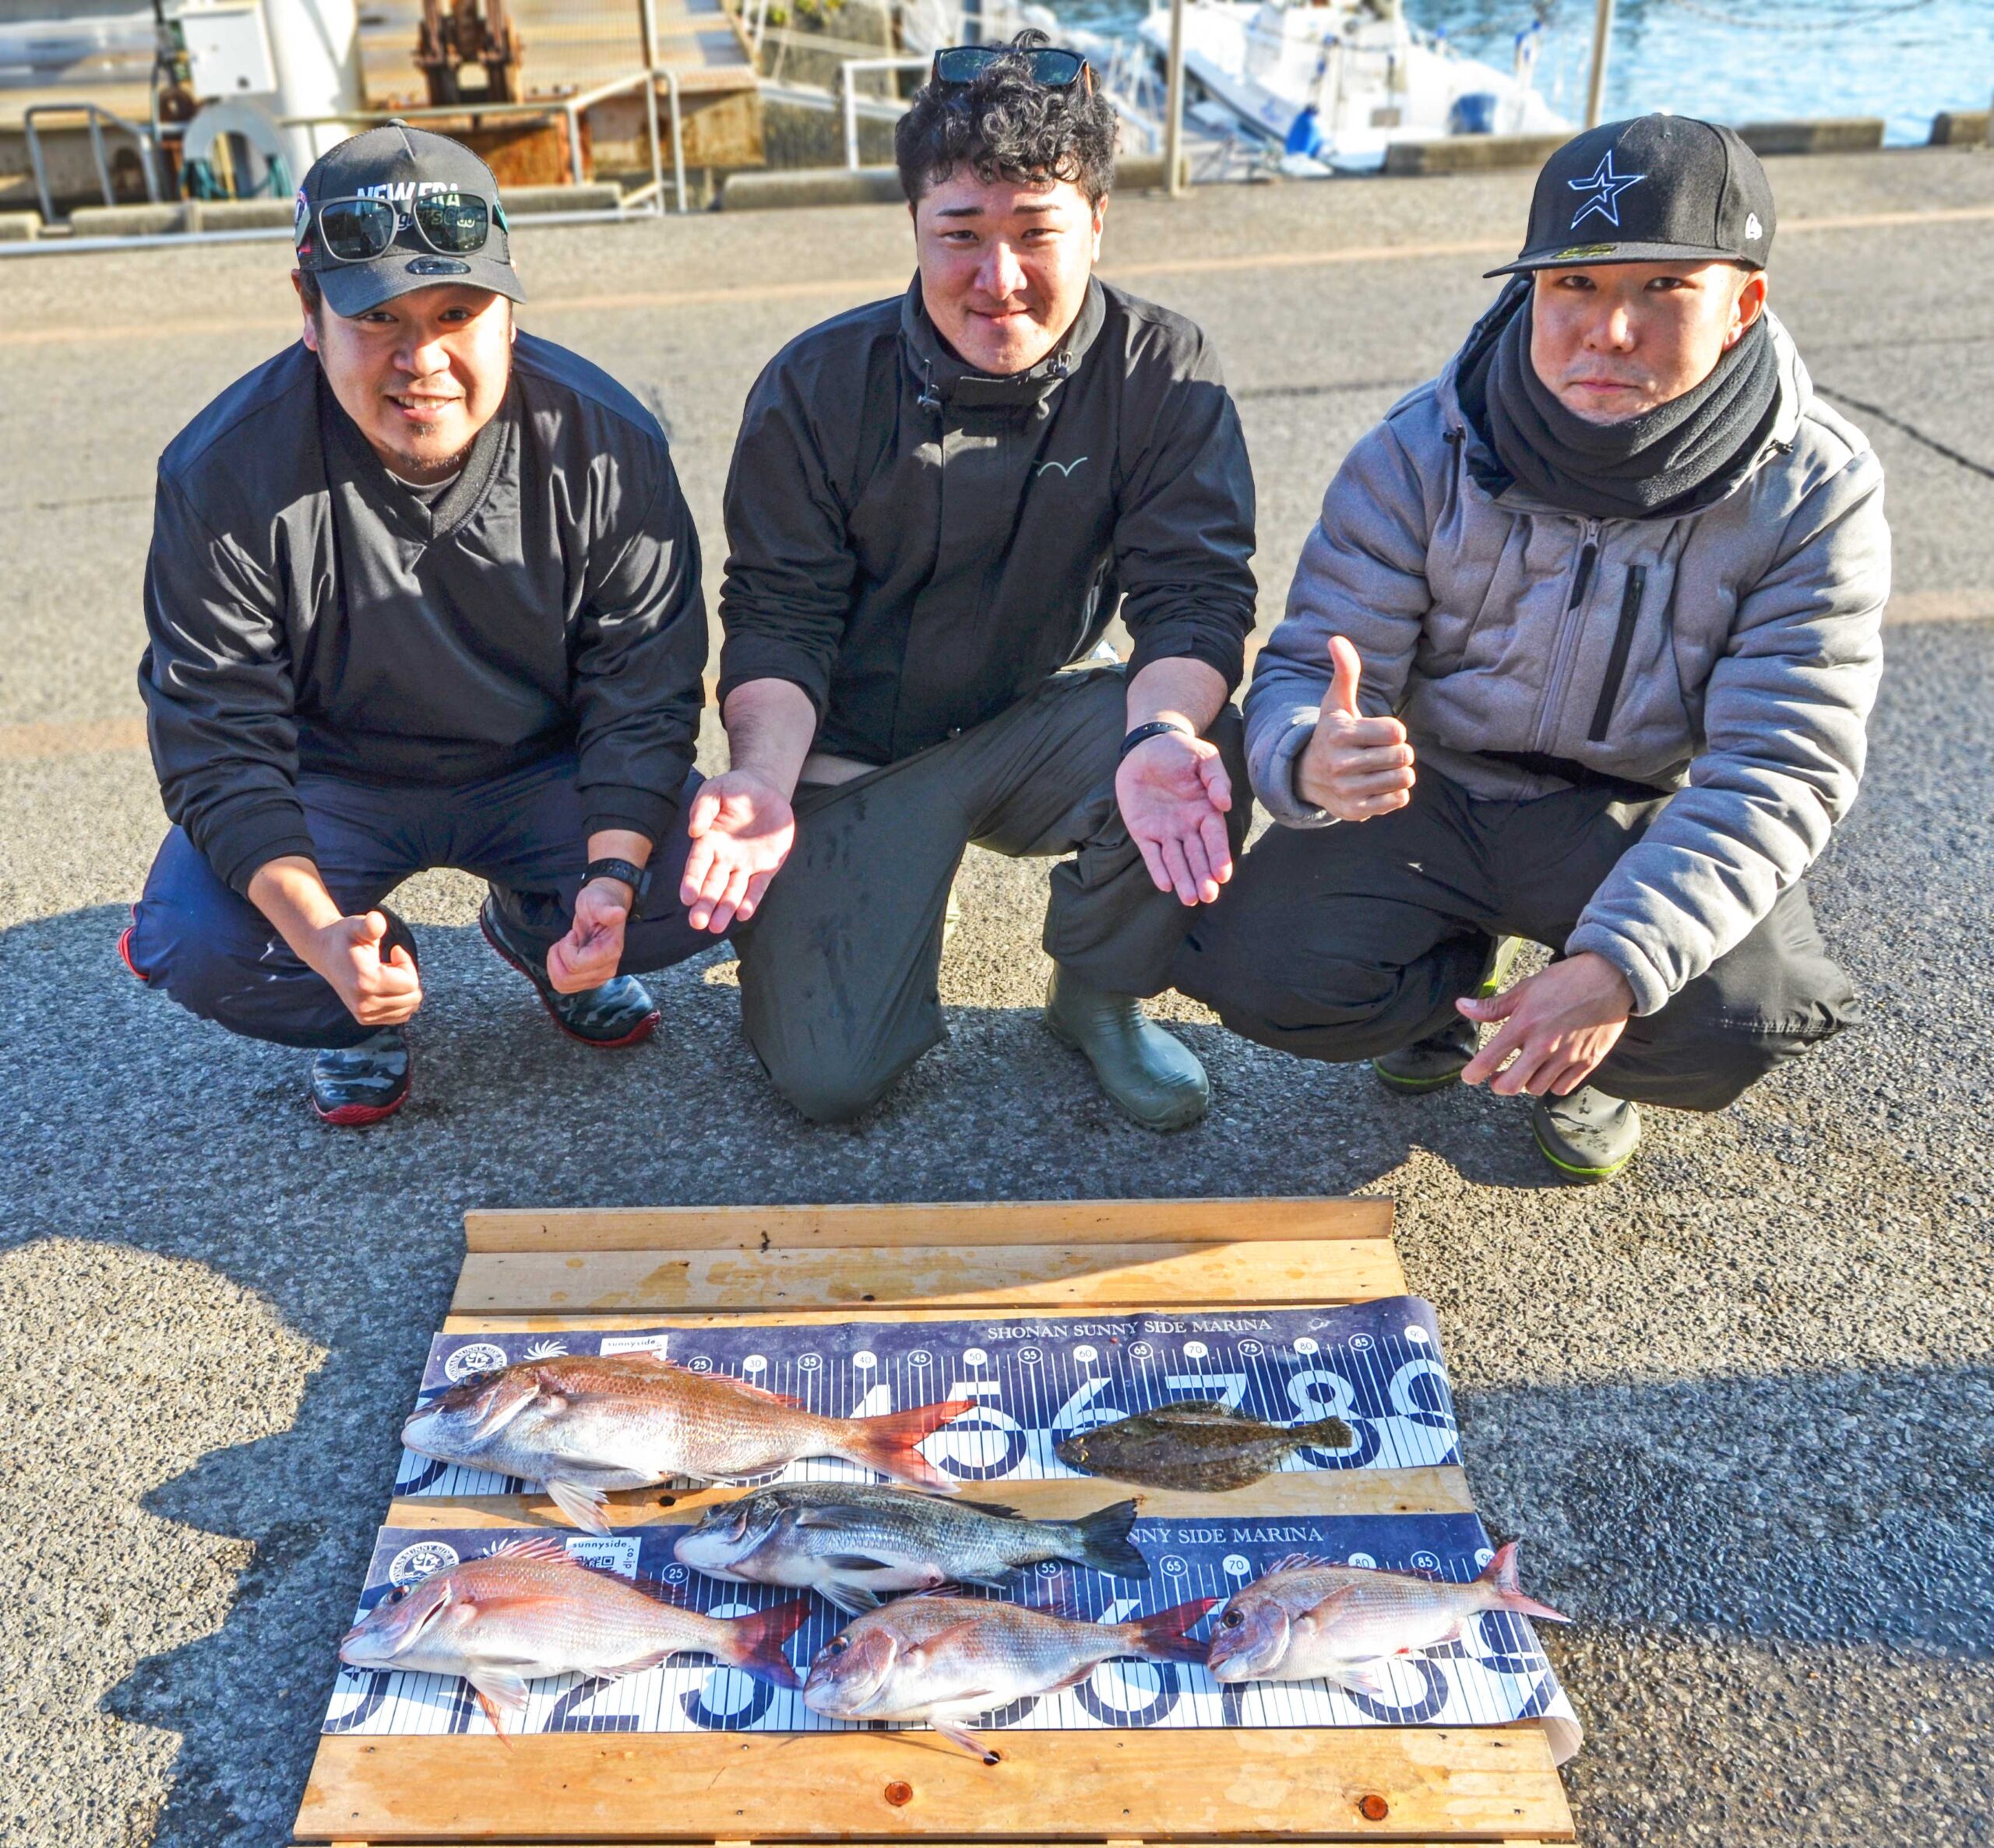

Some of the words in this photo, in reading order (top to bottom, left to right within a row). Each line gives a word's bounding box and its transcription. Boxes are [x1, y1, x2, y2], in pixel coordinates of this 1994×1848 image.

[355, 181, 416, 216] NEW
[417, 181, 461, 207] ERA
[988, 1325, 1068, 1339] SHONAN
[1073, 1322, 1138, 1337] SUNNY
[1144, 1320, 1187, 1333] SIDE
[1193, 1318, 1273, 1332] MARINA
[1244, 1343, 1257, 1352] 75
[1300, 1342, 1312, 1350] 80
[1355, 1338, 1369, 1347] 85
[1079, 1348, 1092, 1358] 60
[1134, 1345, 1147, 1355] 65
[1189, 1345, 1202, 1354] 70
[858, 1355, 872, 1364] 40
[914, 1353, 926, 1364] 45
[969, 1352, 982, 1361] 50
[1023, 1350, 1038, 1360] 55
[693, 1360, 706, 1370] 25
[749, 1359, 762, 1368] 30
[803, 1357, 817, 1367] 35
[1178, 1529, 1227, 1544] SIDE
[1233, 1527, 1324, 1544] MARINA
[1167, 1561, 1182, 1572] 65
[1228, 1560, 1245, 1571] 70
[1417, 1557, 1433, 1567] 85
[1041, 1562, 1056, 1574] 55
[668, 1568, 683, 1579] 25
